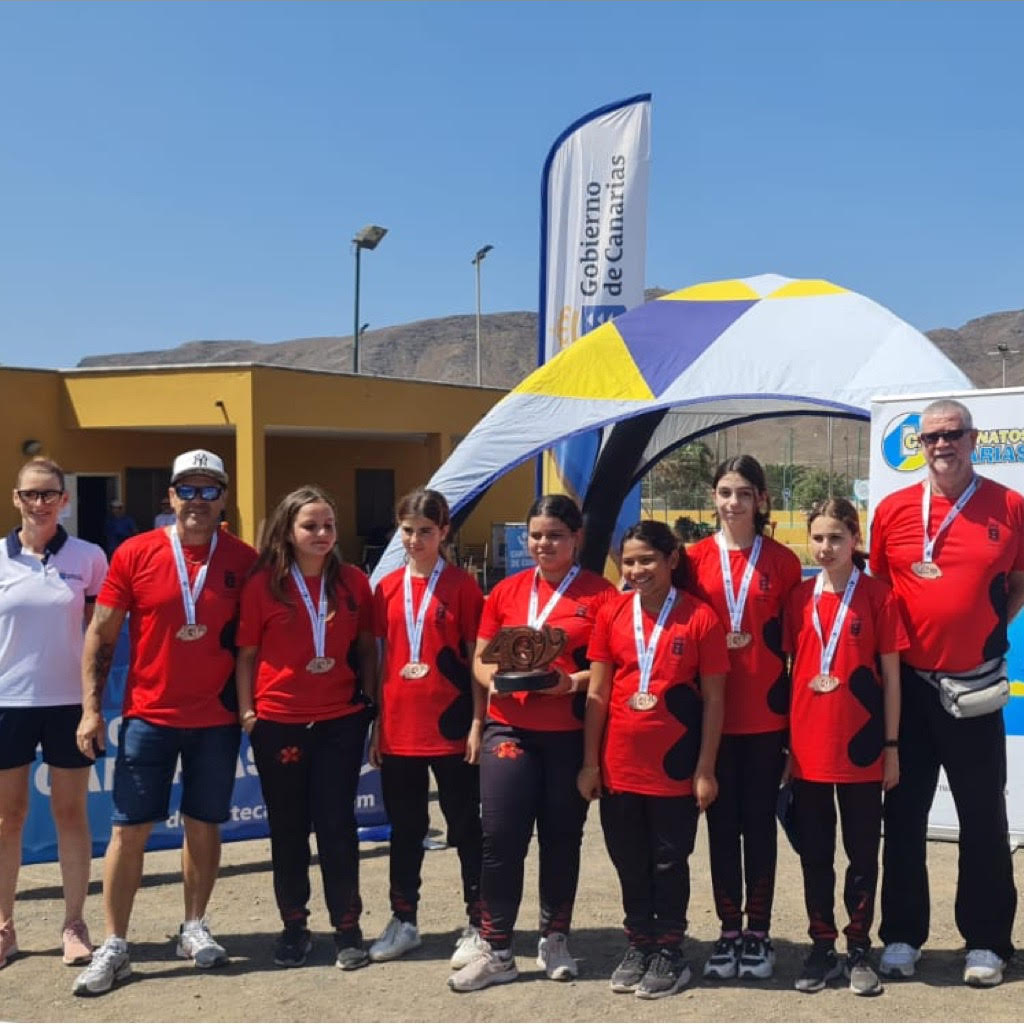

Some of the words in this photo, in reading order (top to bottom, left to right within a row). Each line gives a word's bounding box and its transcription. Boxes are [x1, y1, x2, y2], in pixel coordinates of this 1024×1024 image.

[579, 181, 602, 297] Gobierno
[604, 154, 625, 263] Canarias
[602, 267, 623, 297] de
